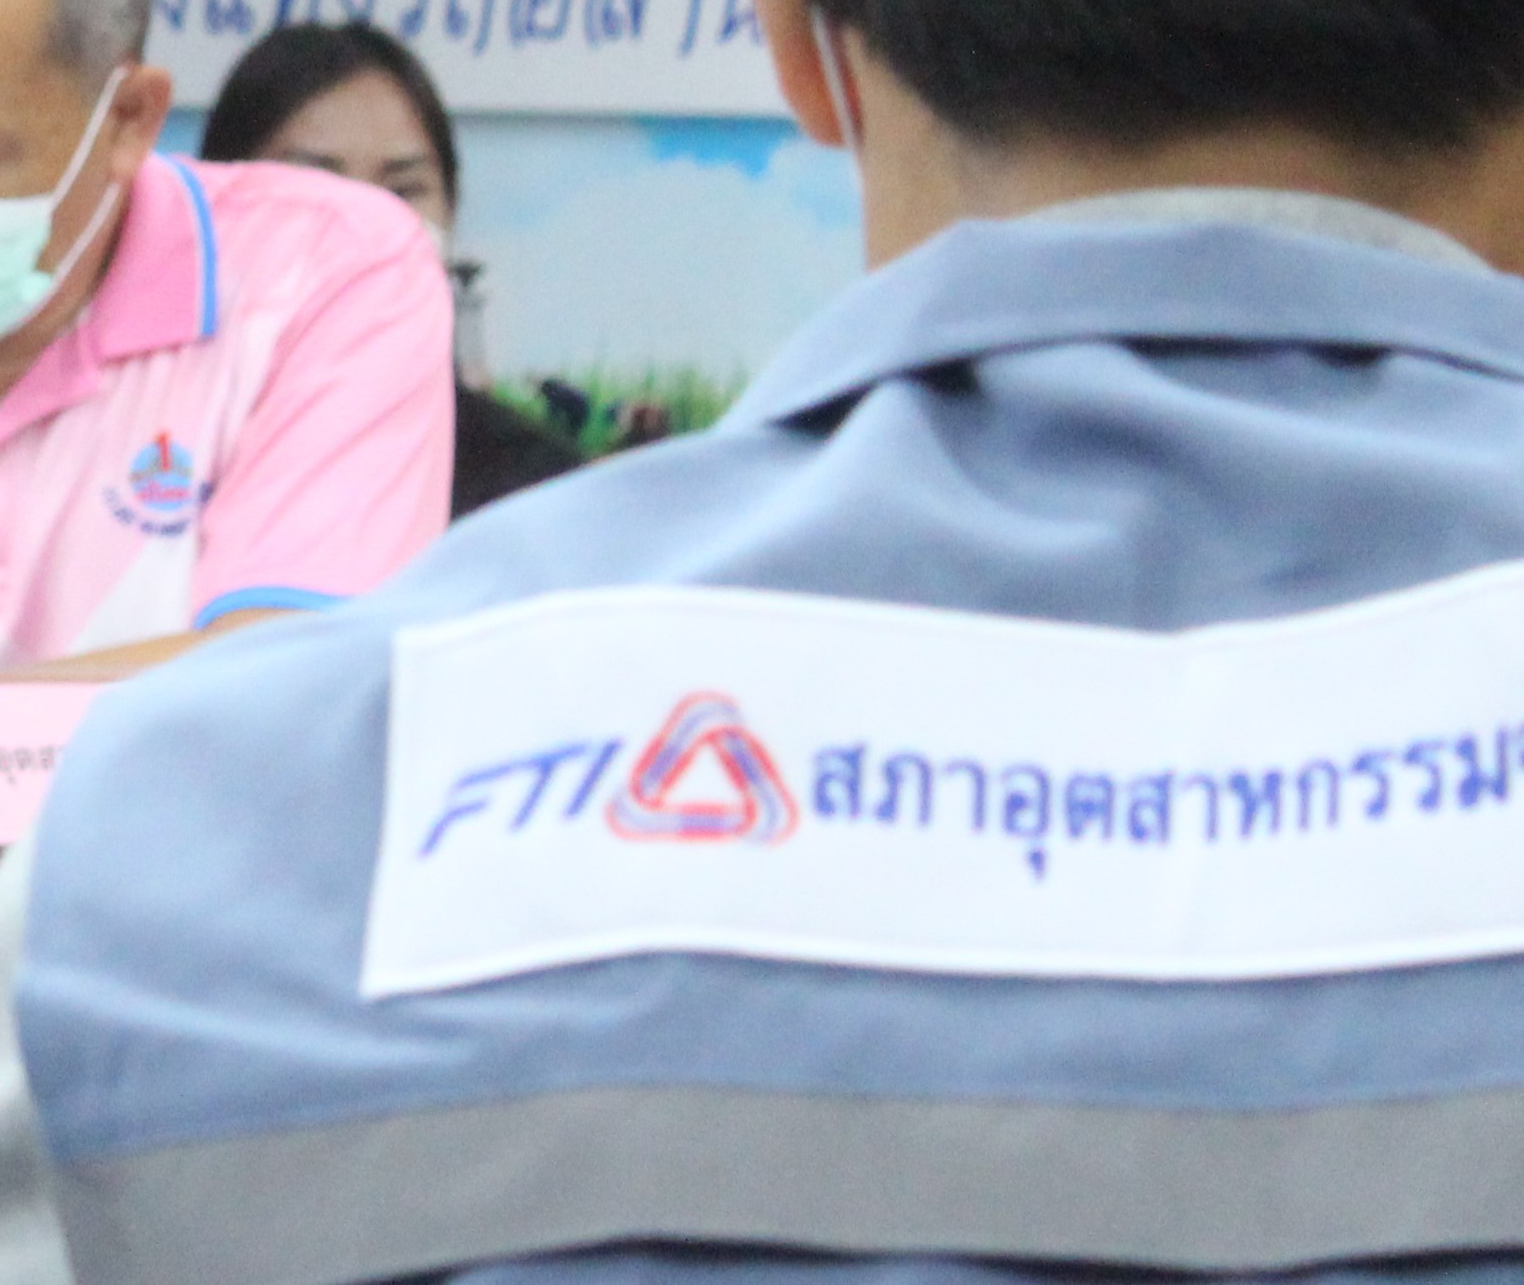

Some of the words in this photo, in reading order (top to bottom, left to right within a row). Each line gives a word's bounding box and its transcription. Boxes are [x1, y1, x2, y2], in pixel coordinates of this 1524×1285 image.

[417, 736, 626, 860] FTI
[811, 722, 1524, 881] สภาอุตสาหกรรม
